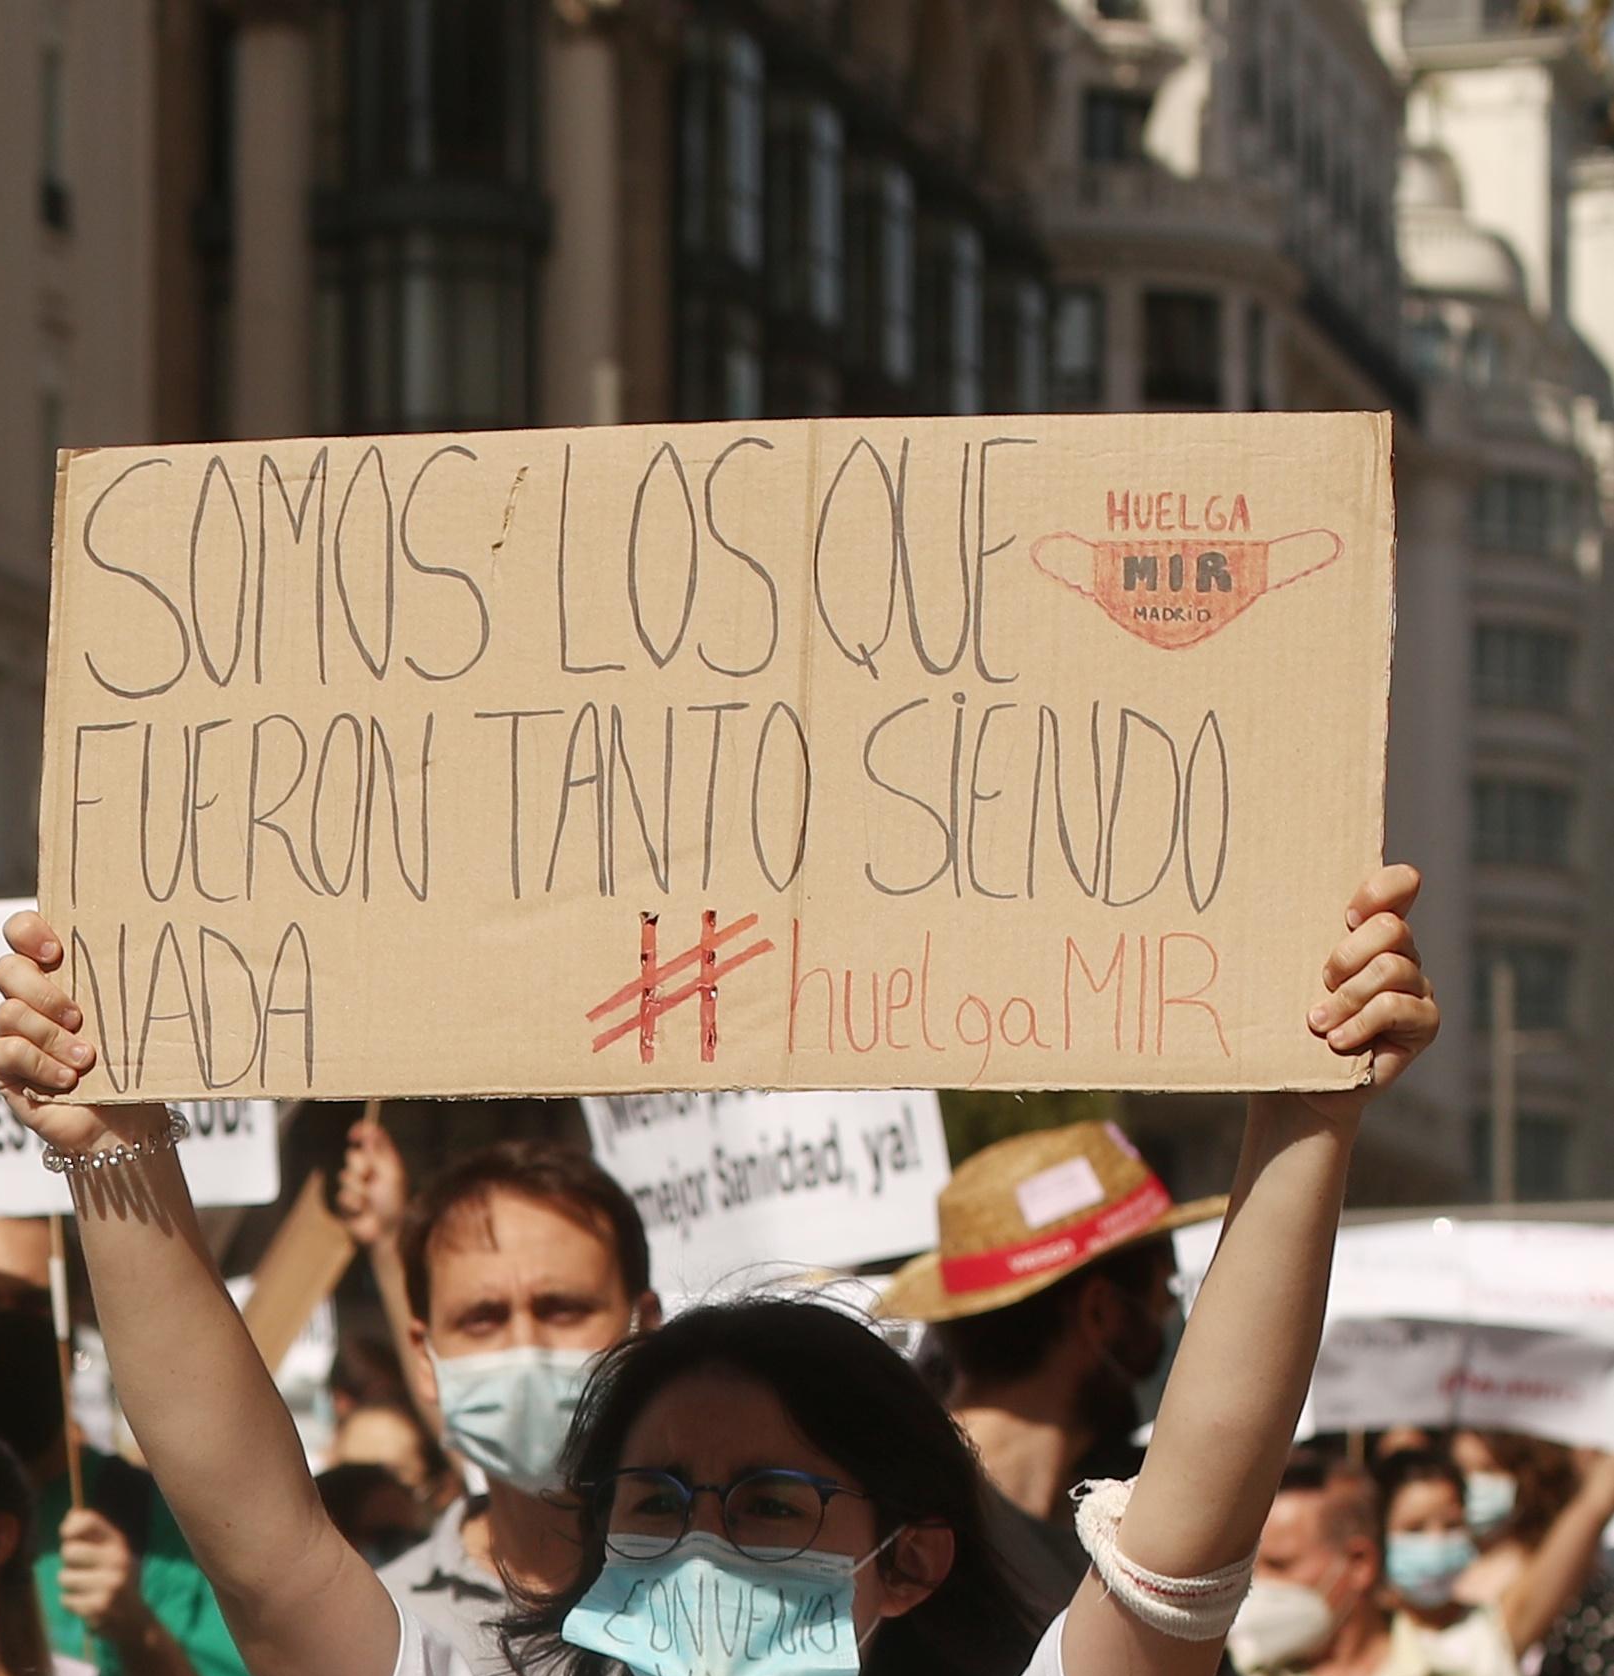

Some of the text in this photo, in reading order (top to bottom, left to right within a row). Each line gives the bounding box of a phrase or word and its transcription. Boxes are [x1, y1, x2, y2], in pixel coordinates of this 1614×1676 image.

[84, 437, 1037, 698] SOMOS LOS QUE
[1106, 490, 1252, 532] HUELGA
[1122, 552, 1233, 593] MIR
[72, 711, 434, 909] FUERON
[473, 701, 810, 900] TANTO
[72, 921, 315, 1094] NADA
[604, 1572, 837, 1661] CONVENIO
